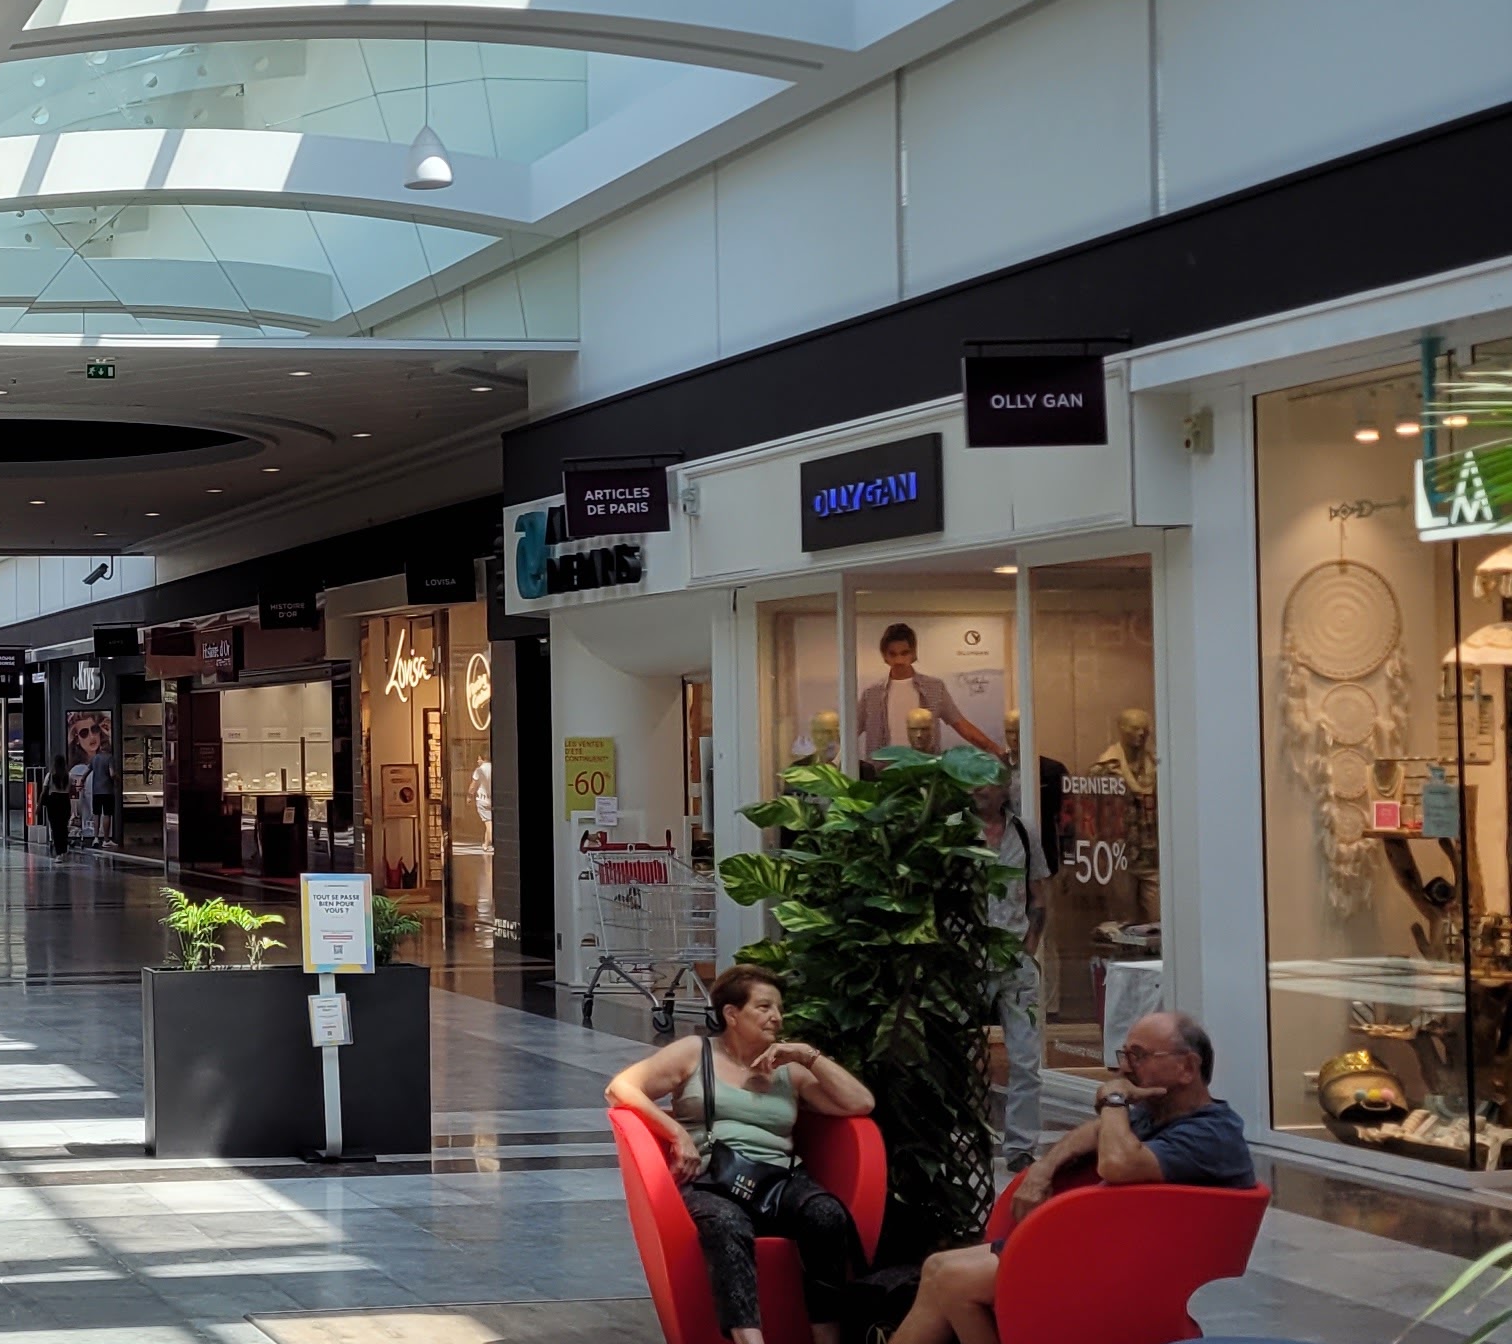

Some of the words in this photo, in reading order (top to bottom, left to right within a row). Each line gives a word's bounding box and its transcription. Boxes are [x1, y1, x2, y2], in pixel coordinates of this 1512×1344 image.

[991, 394, 1037, 409] OLLY
[1042, 393, 1083, 408] GAN
[584, 487, 651, 502] ARTICLES
[587, 505, 606, 516] DE
[609, 502, 650, 514] PARIS
[425, 577, 457, 587] LOVISA
[269, 602, 306, 612] HISTOIRE
[278, 611, 298, 619] D'OR
[385, 628, 432, 703] Lovisa
[1062, 776, 1127, 796] DERNIERS
[1063, 840, 1128, 886] -50%
